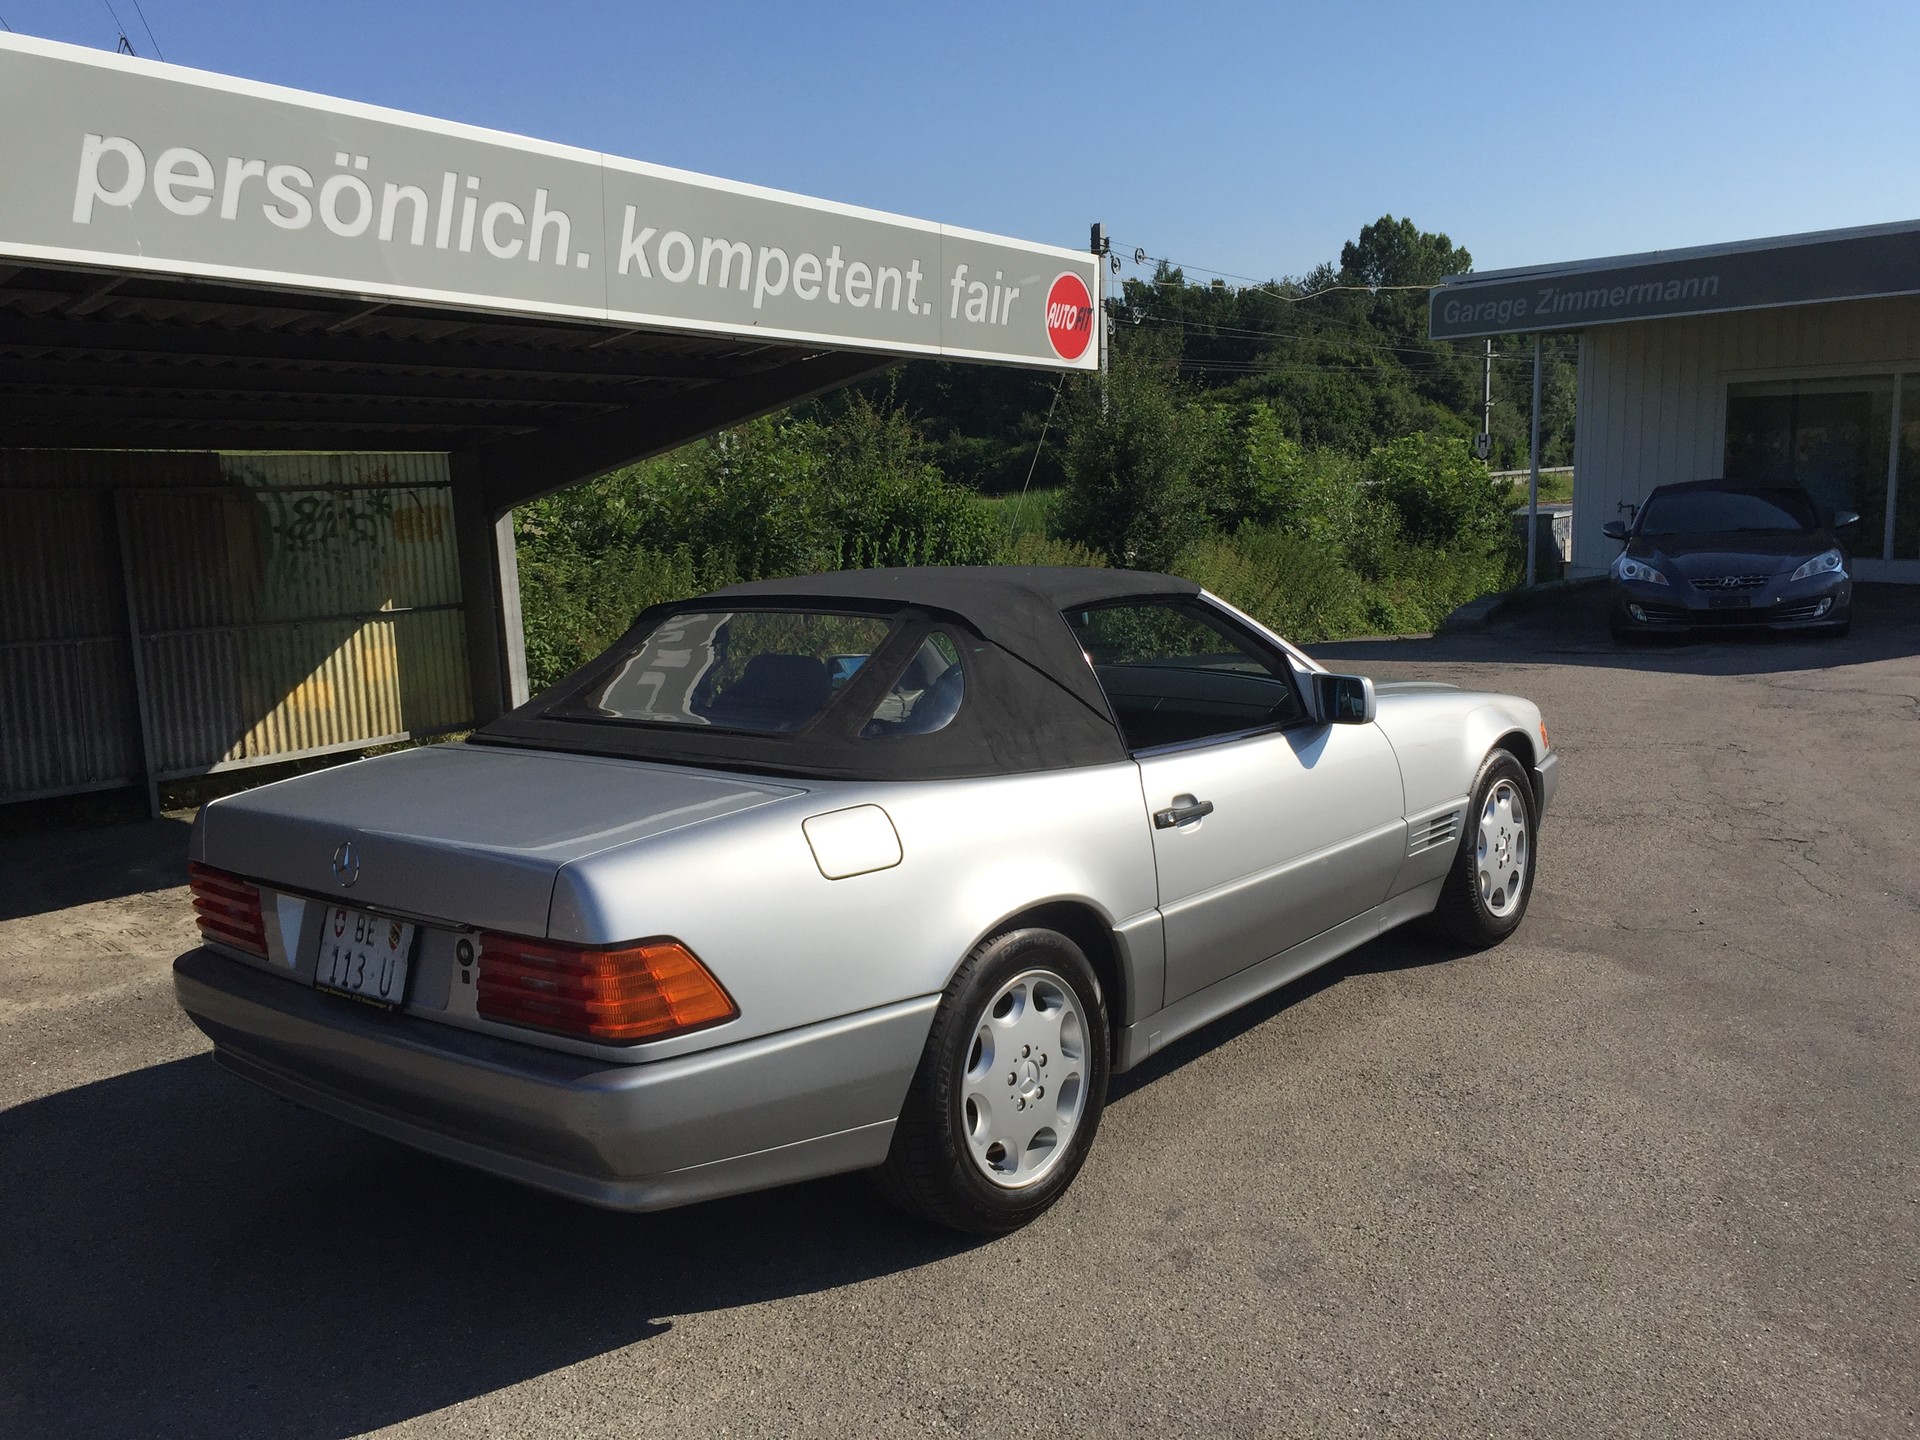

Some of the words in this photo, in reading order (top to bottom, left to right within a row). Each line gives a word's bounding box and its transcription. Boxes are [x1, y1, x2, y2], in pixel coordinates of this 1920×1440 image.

[72, 132, 591, 269] persönlich.
[618, 203, 932, 316] kompetent.
[950, 263, 1020, 326] fair
[1443, 299, 1527, 325] Garage
[1534, 276, 1720, 315] Zimmermann
[355, 915, 378, 947] BE
[329, 945, 366, 989] 113
[379, 957, 396, 997] U
